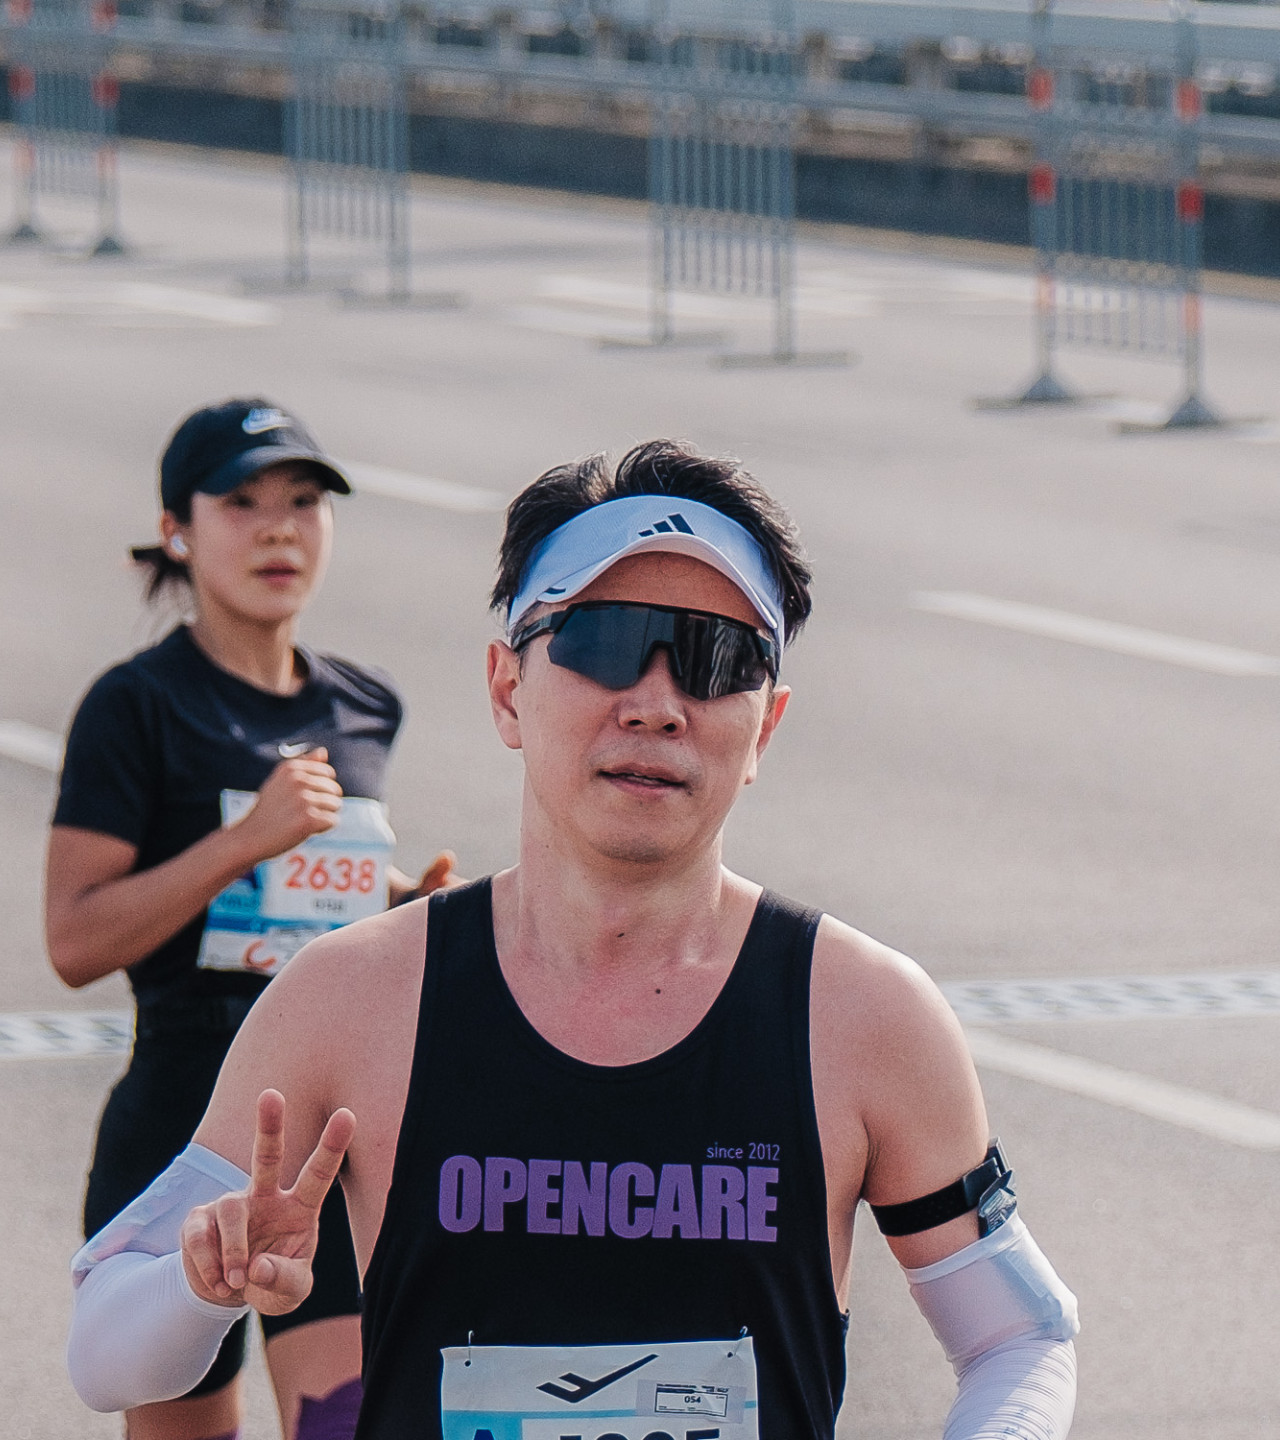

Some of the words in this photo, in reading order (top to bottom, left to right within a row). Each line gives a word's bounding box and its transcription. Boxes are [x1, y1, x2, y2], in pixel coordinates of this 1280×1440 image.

[285, 855, 376, 894] 2638
[706, 1141, 743, 1159] since
[748, 1142, 780, 1161] 2012
[438, 1155, 779, 1242] OPENCARE
